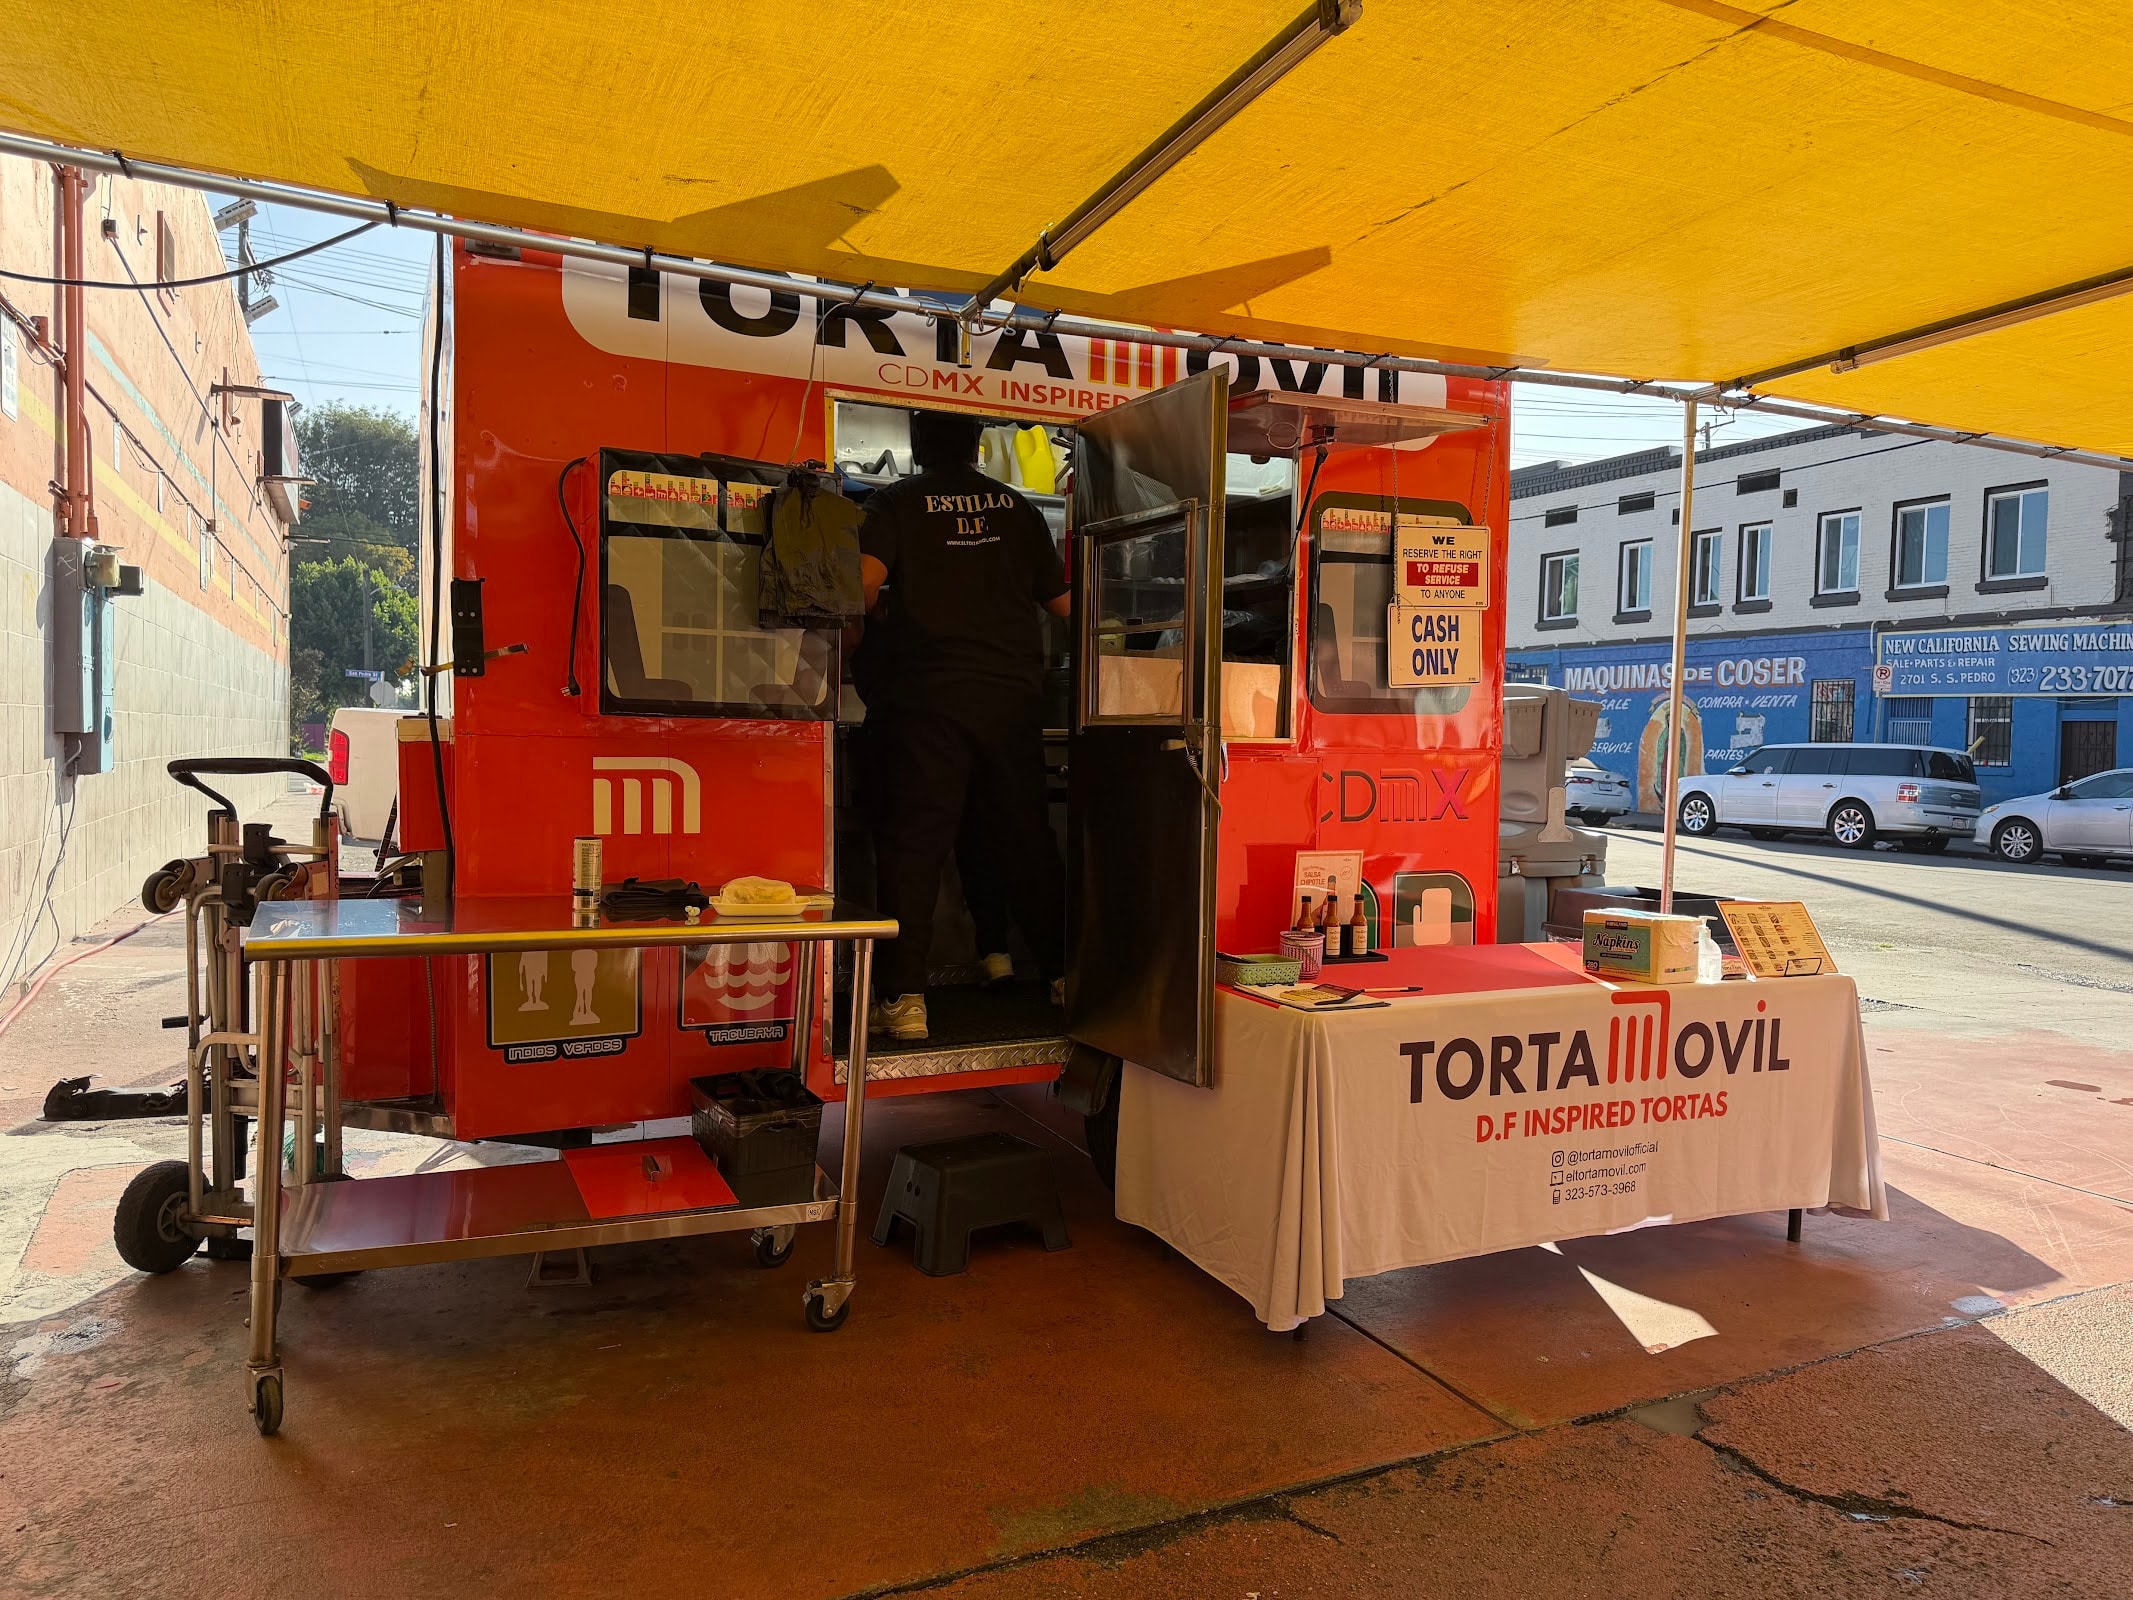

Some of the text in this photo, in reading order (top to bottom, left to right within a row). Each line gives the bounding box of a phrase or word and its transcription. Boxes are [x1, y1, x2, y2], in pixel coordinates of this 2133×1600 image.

[878, 363, 985, 396] CDMX
[924, 493, 1014, 513] ESTILLO
[1432, 536, 1455, 545] WE
[1402, 548, 1483, 559] RESERVE THE RIGHT
[1416, 563, 1469, 574] TO REFUSE
[1424, 575, 1461, 585] SERVICE
[1420, 589, 1466, 599] TO ANYONE
[1411, 614, 1460, 643] CASH
[1885, 639, 1917, 655] NEW
[1917, 635, 2000, 654] CALIFORNIA
[2008, 633, 2069, 652] SEWING
[1412, 648, 1460, 677] ONLY
[1947, 659, 1956, 668] &
[1957, 657, 1996, 668] REPAIR
[1564, 656, 1807, 694] MAQUINAS DE COSER
[1900, 672, 1996, 685] 2701 S. S. PEDRO
[2007, 665, 2039, 688] (323)
[1600, 698, 1632, 711] SALE
[1697, 694, 1798, 709] COMPRA VENTA
[1589, 741, 1633, 754] SERVICE
[1704, 749, 1744, 761] PARTES
[1592, 932, 1641, 951] Napkins
[709, 1026, 784, 1043] TACUBAYA
[508, 1039, 623, 1061] INDIOS VERDES
[1476, 1091, 1728, 1143] D.F INSPIRED TORTAS
[1567, 1140, 1659, 1166] @tortamovilofficial
[1565, 1162, 1647, 1182] eltortamovil.com
[1564, 1180, 1636, 1201] 323-573-3968
